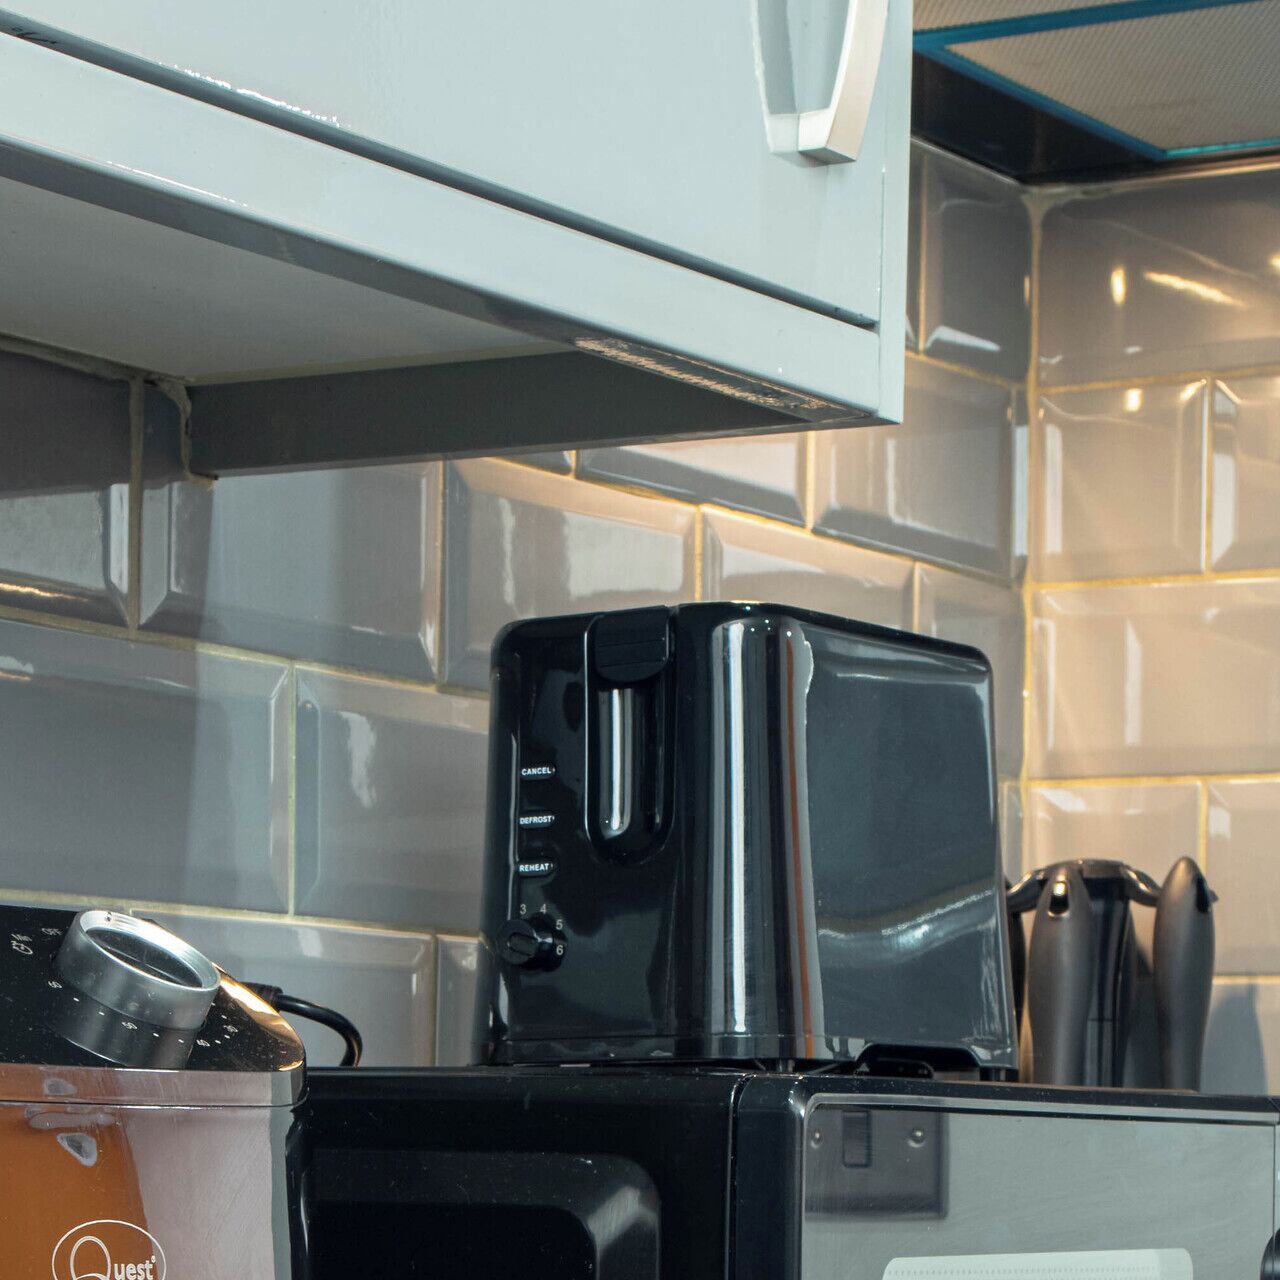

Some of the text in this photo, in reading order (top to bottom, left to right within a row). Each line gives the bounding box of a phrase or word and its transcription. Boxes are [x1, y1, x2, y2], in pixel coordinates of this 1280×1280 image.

[521, 767, 551, 776] CANCEL
[520, 815, 552, 825] DEFROST
[519, 863, 549, 872] REHEAT
[520, 904, 547, 915] 3 4
[556, 919, 563, 930] 5
[556, 944, 564, 956] 6
